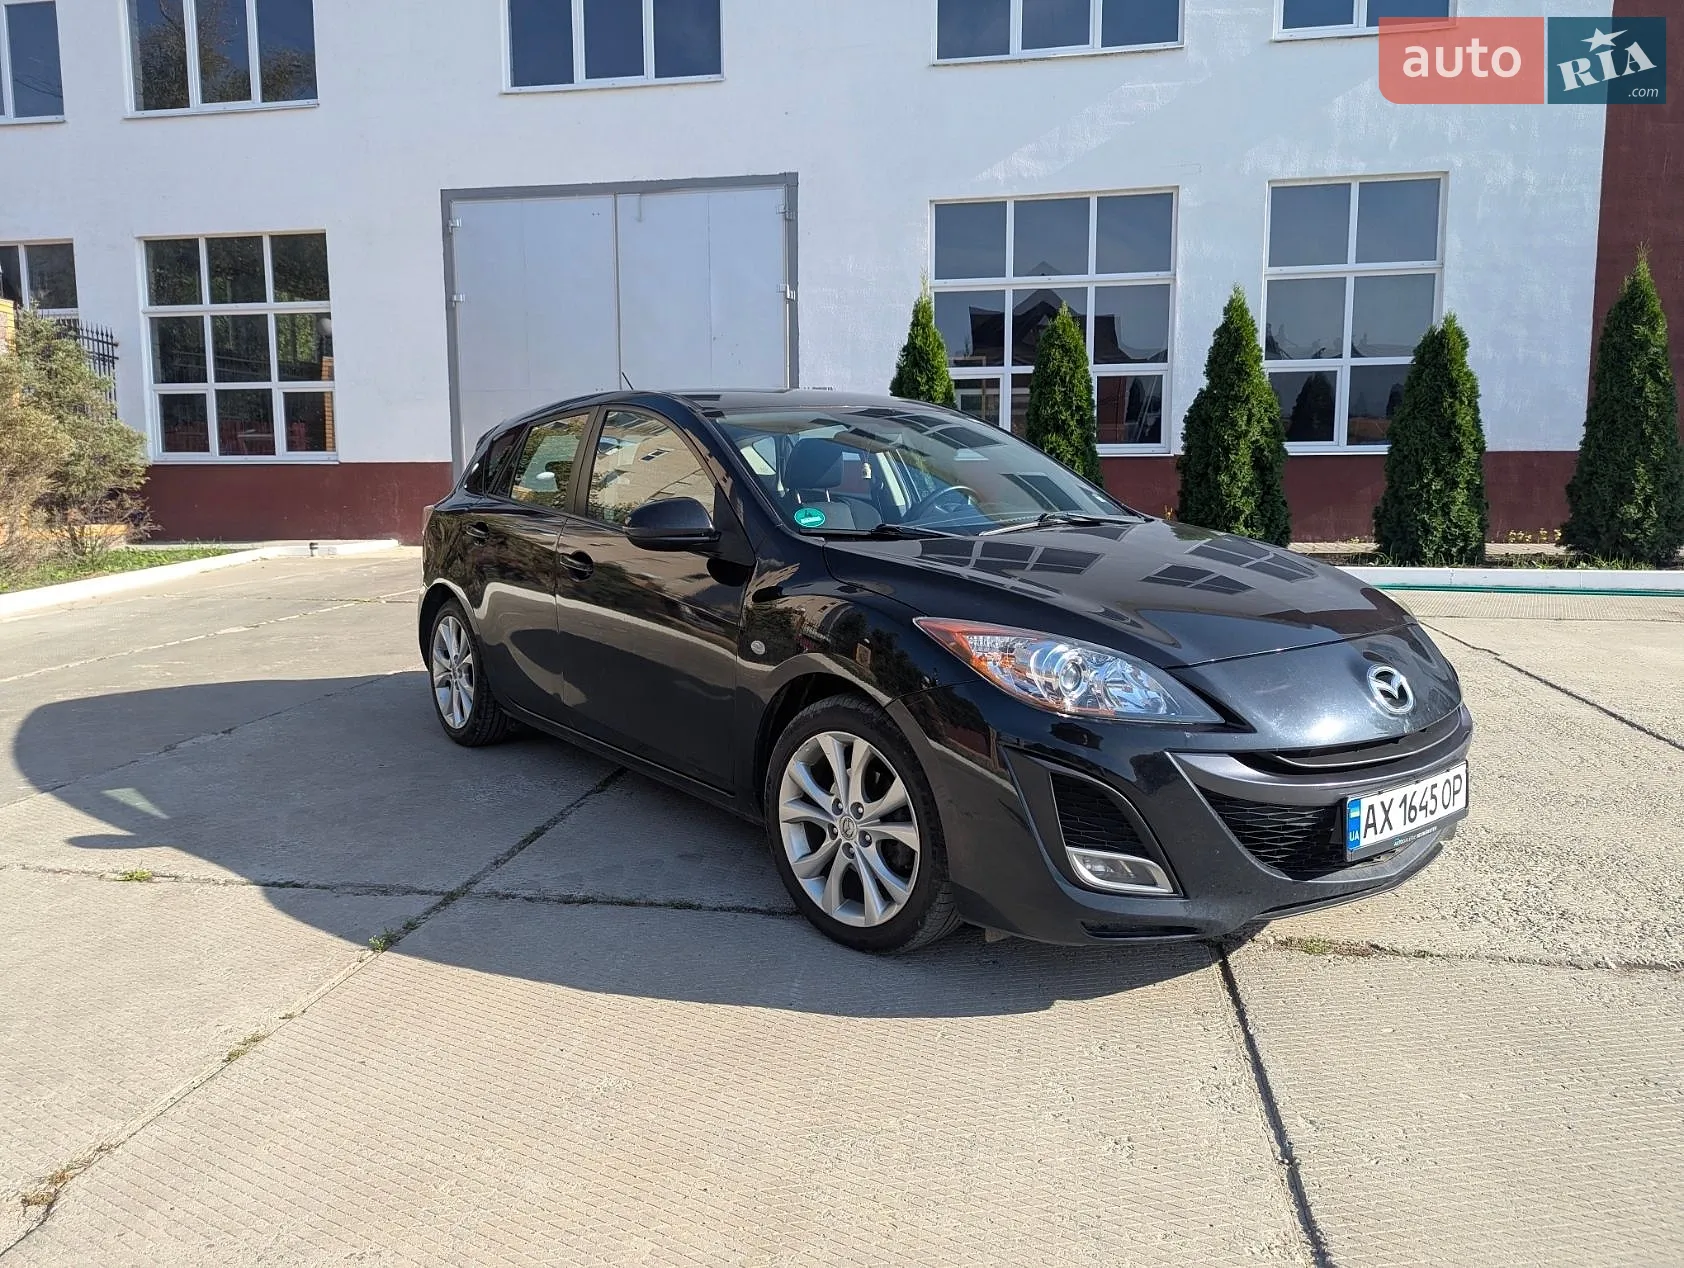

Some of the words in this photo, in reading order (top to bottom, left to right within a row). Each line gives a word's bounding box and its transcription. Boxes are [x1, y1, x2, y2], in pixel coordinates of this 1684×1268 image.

[1363, 798, 1394, 839] AX
[1399, 783, 1438, 826] 1645
[1441, 773, 1463, 810] OP
[1349, 831, 1360, 841] UA
